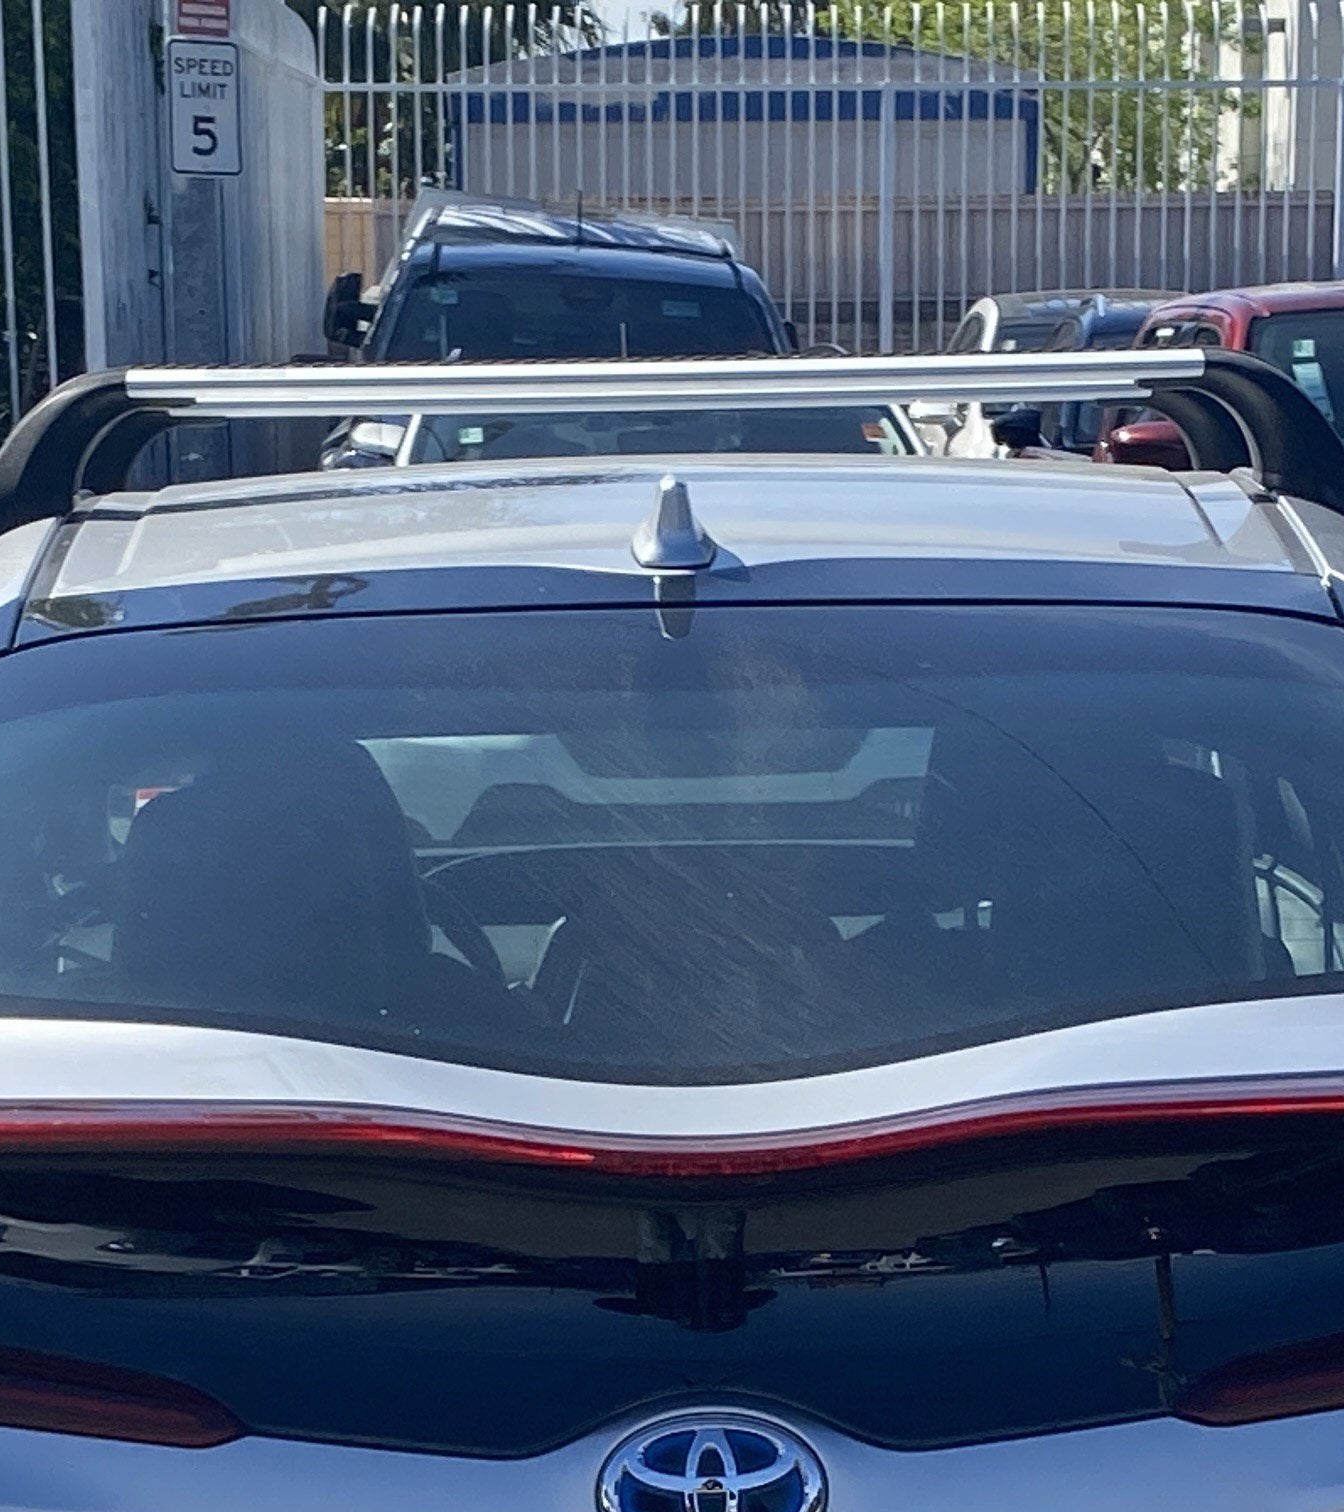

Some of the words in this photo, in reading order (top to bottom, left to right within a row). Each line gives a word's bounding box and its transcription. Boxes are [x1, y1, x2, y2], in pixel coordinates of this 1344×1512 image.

[173, 57, 233, 77] SPEED
[180, 82, 227, 98] LIMIT
[192, 115, 218, 156] 5
